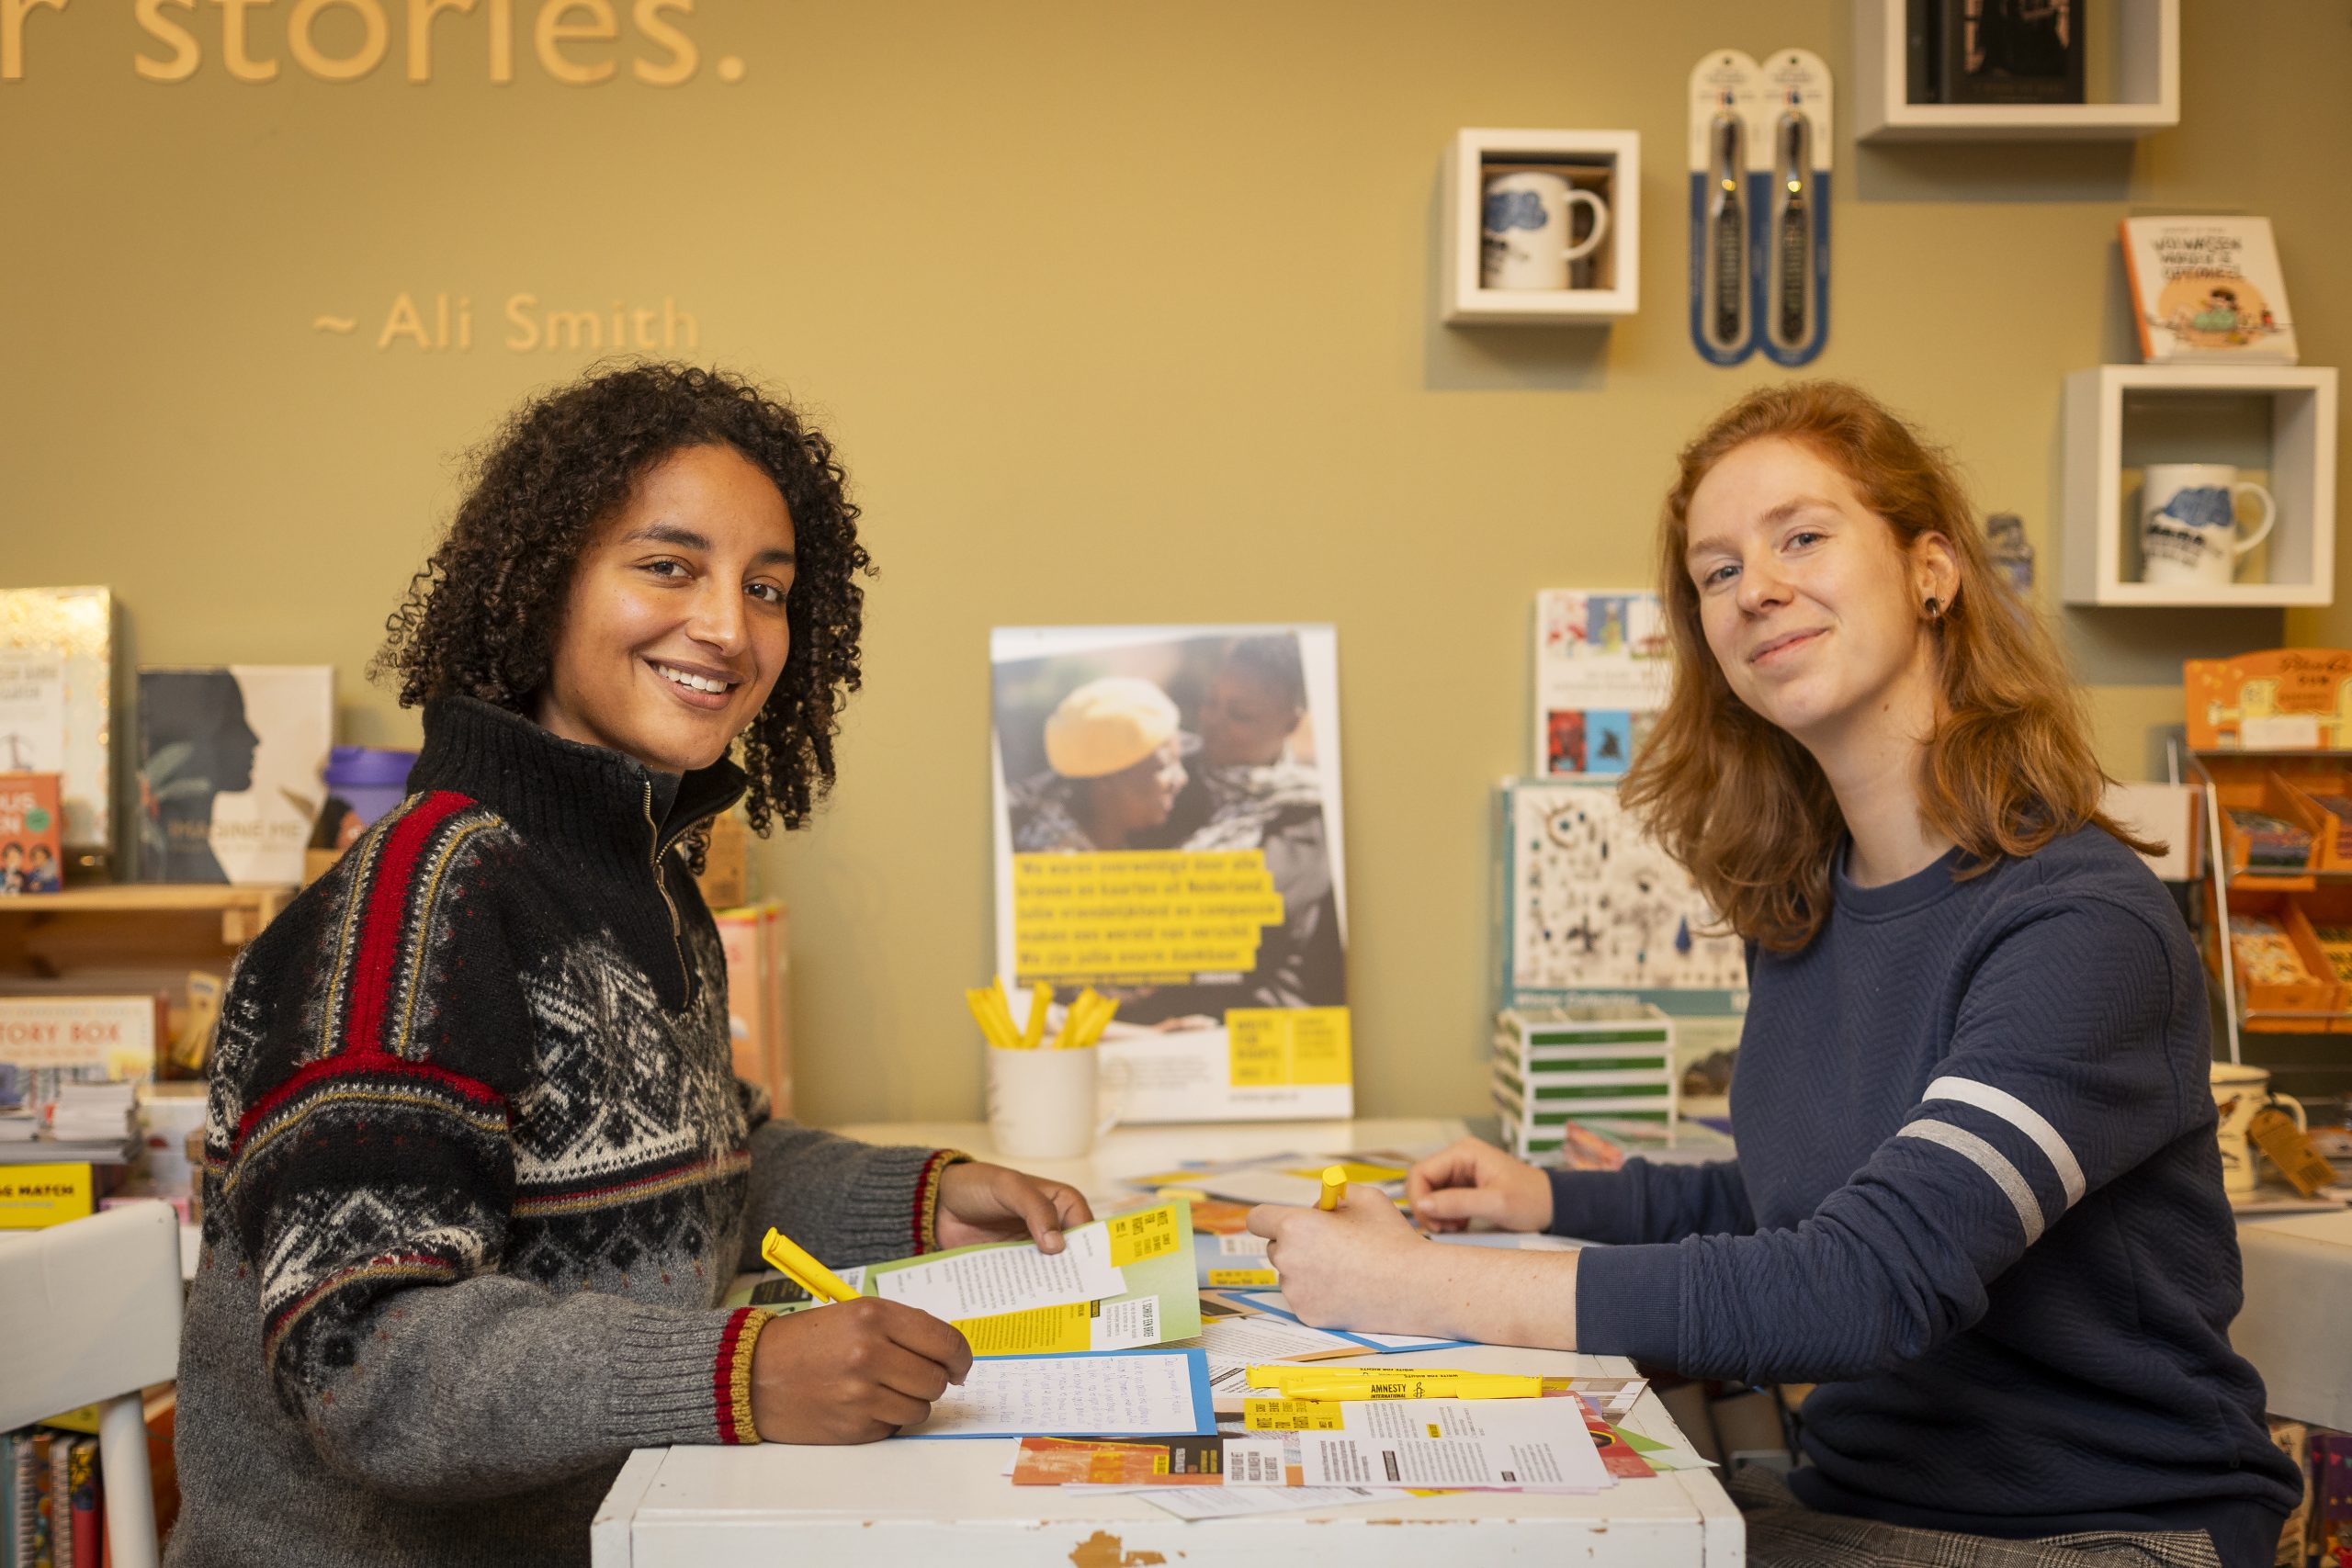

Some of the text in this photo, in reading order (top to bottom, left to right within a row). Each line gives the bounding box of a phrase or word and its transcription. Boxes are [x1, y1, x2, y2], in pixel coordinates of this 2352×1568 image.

[134, 0, 746, 85] stories.
[378, 294, 473, 350] Ali
[505, 294, 699, 351] Smith
[1371, 1384, 1407, 1393] AMNESTY
